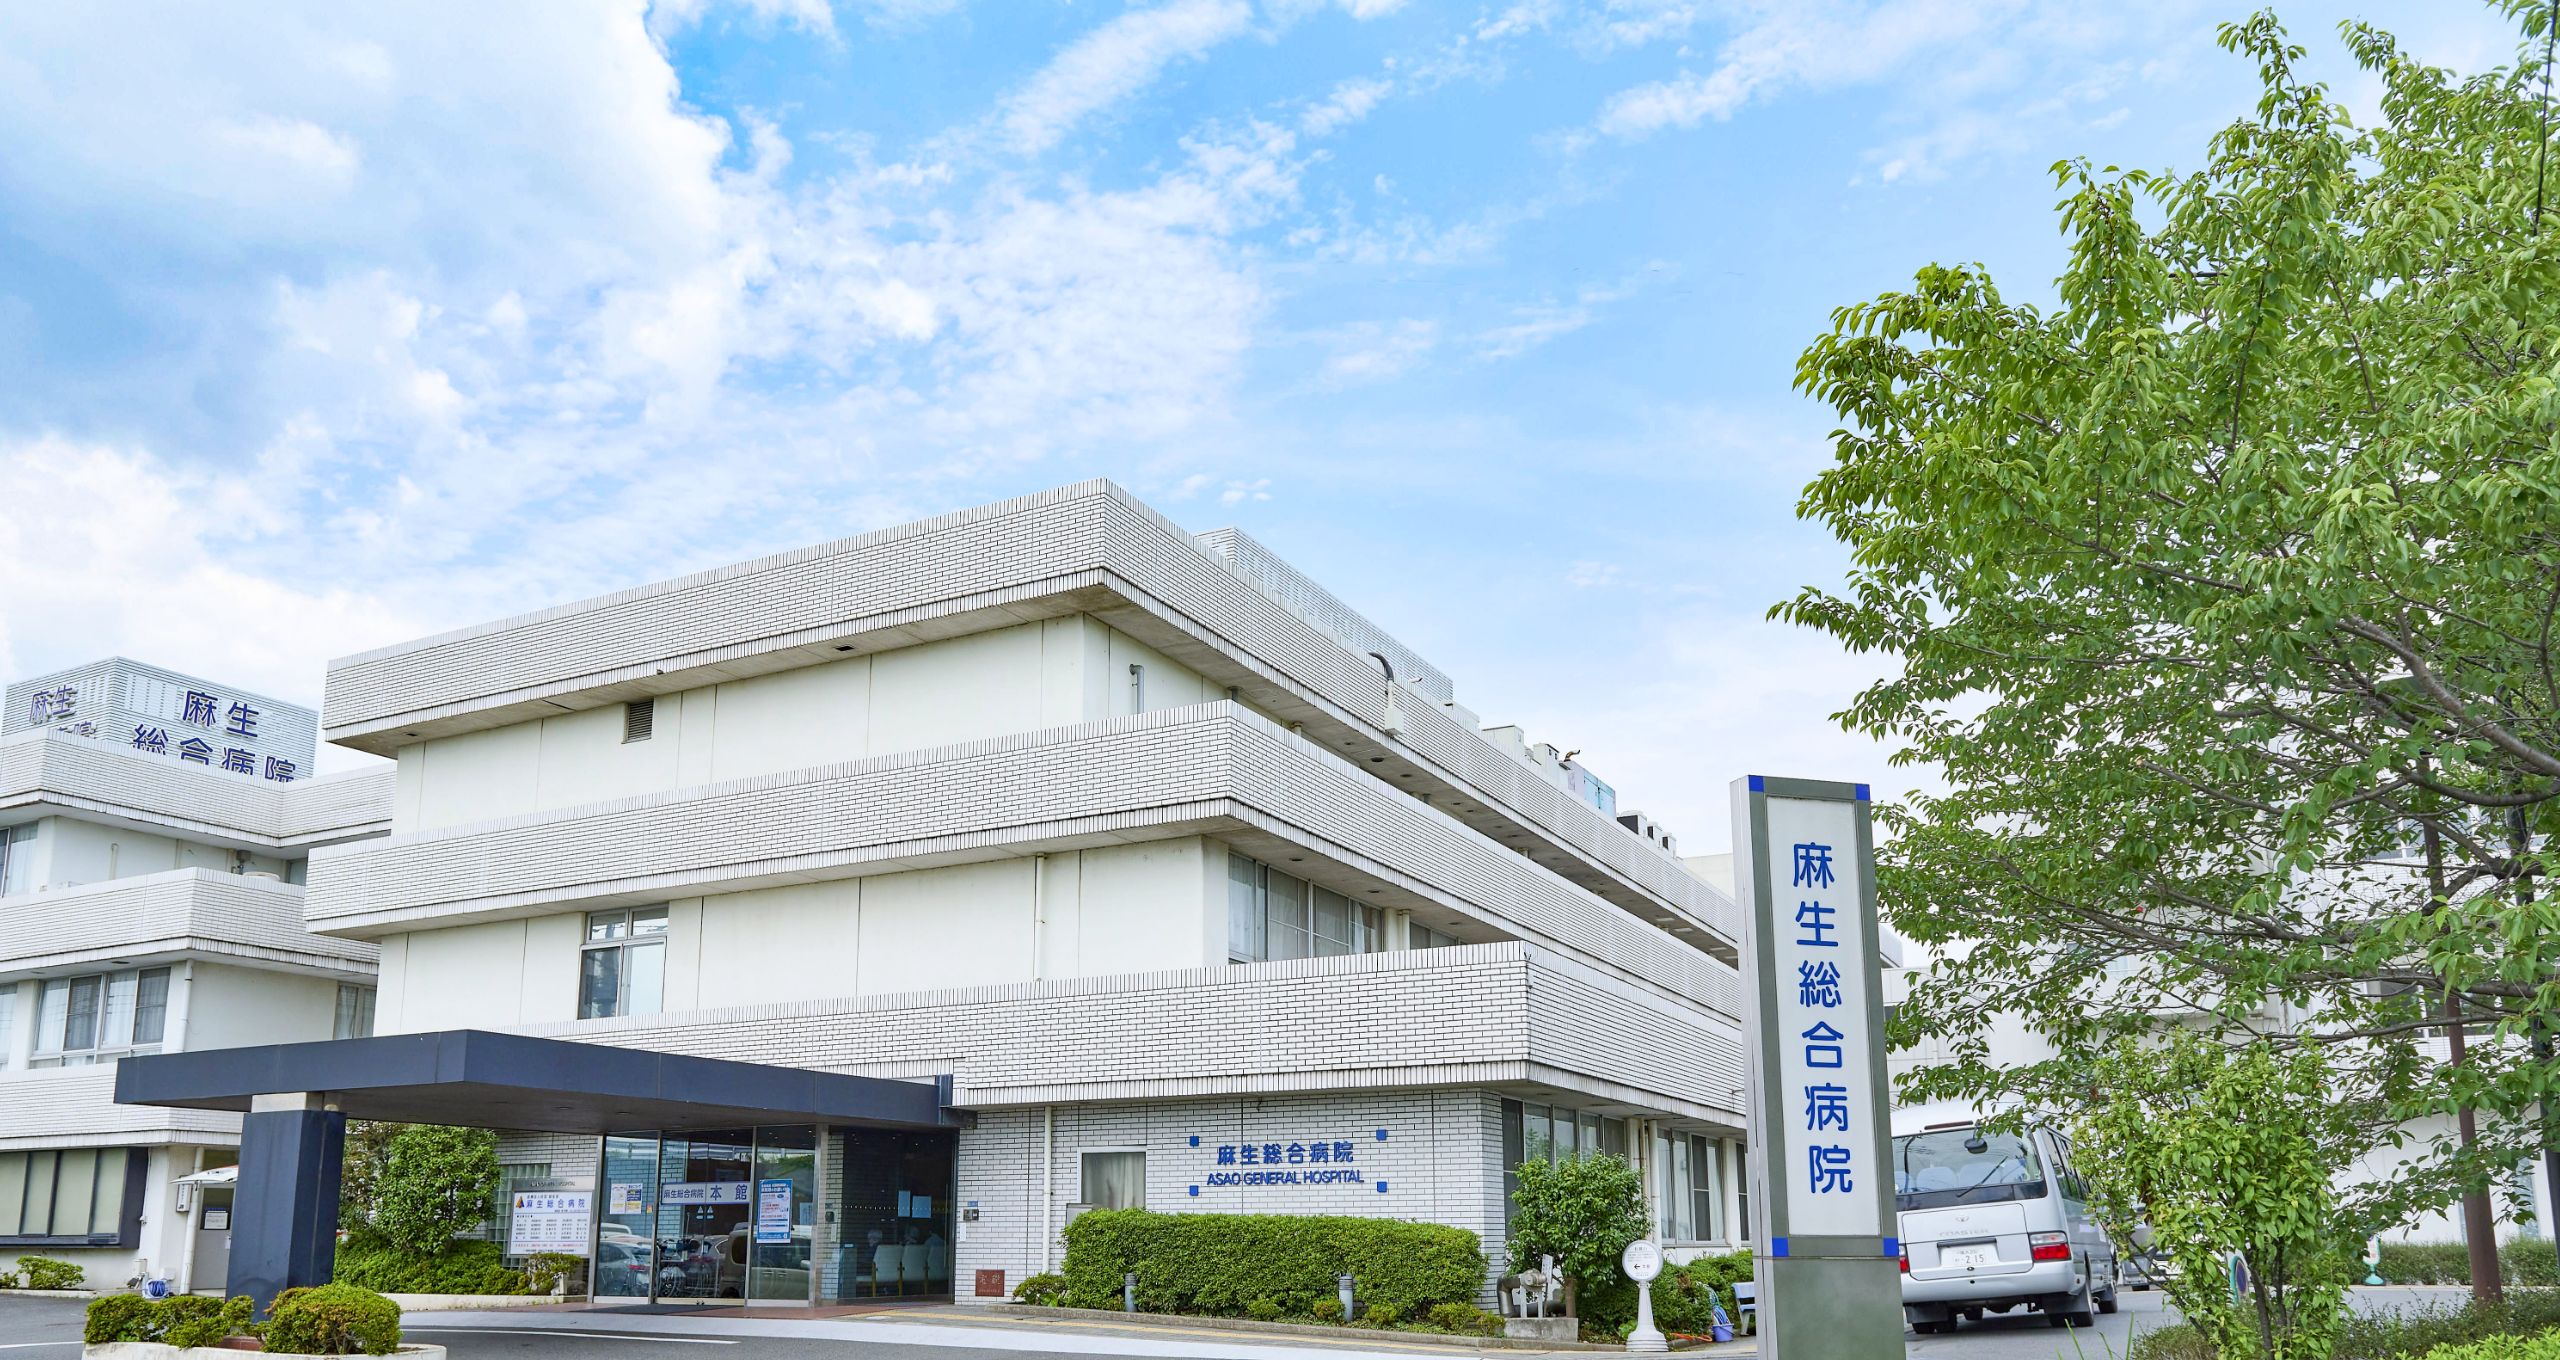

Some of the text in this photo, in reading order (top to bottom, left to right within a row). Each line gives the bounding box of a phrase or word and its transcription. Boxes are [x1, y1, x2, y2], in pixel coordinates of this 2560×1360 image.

[29, 685, 74, 722] 麻生
[182, 690, 259, 738] 麻生
[1792, 842, 1854, 1194] 麻生総合病院
[1217, 1141, 1354, 1166] 麻生総合病院
[663, 1184, 748, 1201] 麻生総合病院 本館
[1206, 1169, 1365, 1186] ASAO GENERAL HOSPITAL
